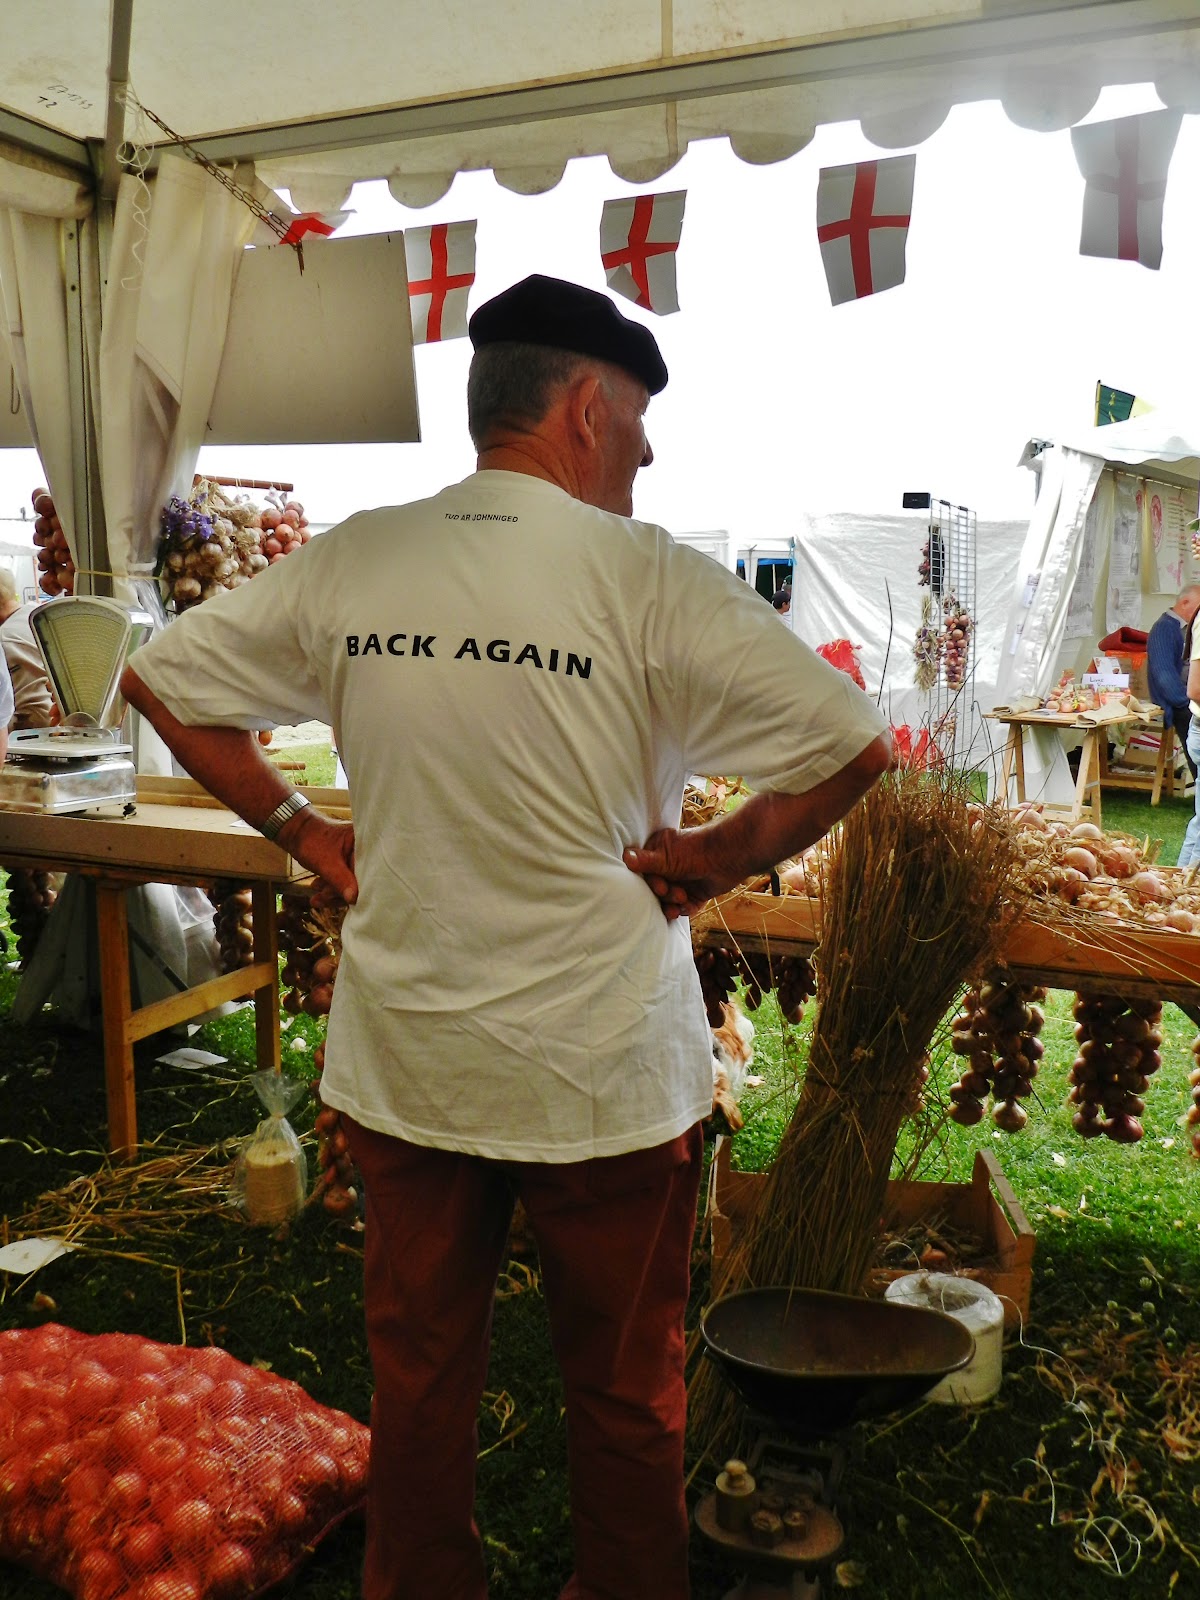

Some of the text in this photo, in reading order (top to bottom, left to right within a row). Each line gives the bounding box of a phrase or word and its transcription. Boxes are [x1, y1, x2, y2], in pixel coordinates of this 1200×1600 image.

[444, 513, 519, 523] TUD AR JOHNNIGED
[346, 633, 592, 680] BACK AGAIN
